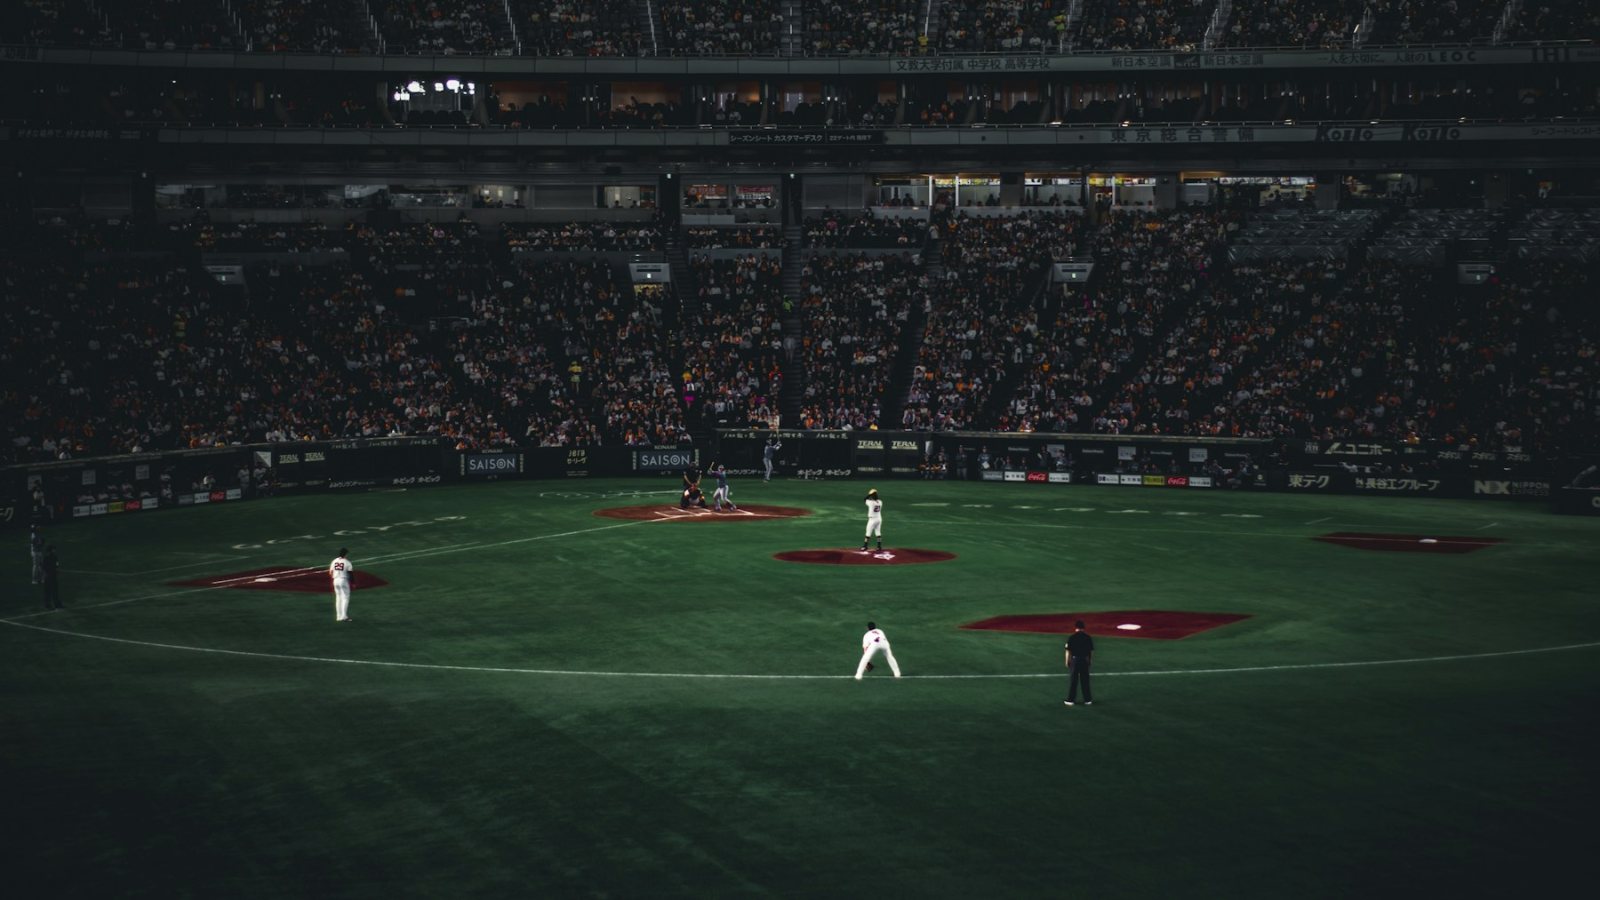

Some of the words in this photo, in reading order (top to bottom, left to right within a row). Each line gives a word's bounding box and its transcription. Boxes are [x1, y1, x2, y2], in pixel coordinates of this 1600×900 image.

[1427, 51, 1476, 63] LEOC
[1531, 48, 1570, 64] IHI
[967, 59, 1001, 71] 中学校
[1005, 58, 1050, 70] 高等学校
[774, 134, 823, 143] カスタマーデスク
[1111, 127, 1254, 142] 東京総合警備
[1345, 444, 1392, 455] ユニホー
[469, 457, 516, 471] SAISON
[642, 454, 690, 466] SAISON
[1288, 473, 1329, 488] 東テク
[1365, 477, 1441, 490] 長谷工グループ
[1473, 479, 1511, 495] NX
[1512, 481, 1550, 489] NIPPON
[334, 562, 345, 571] 29
